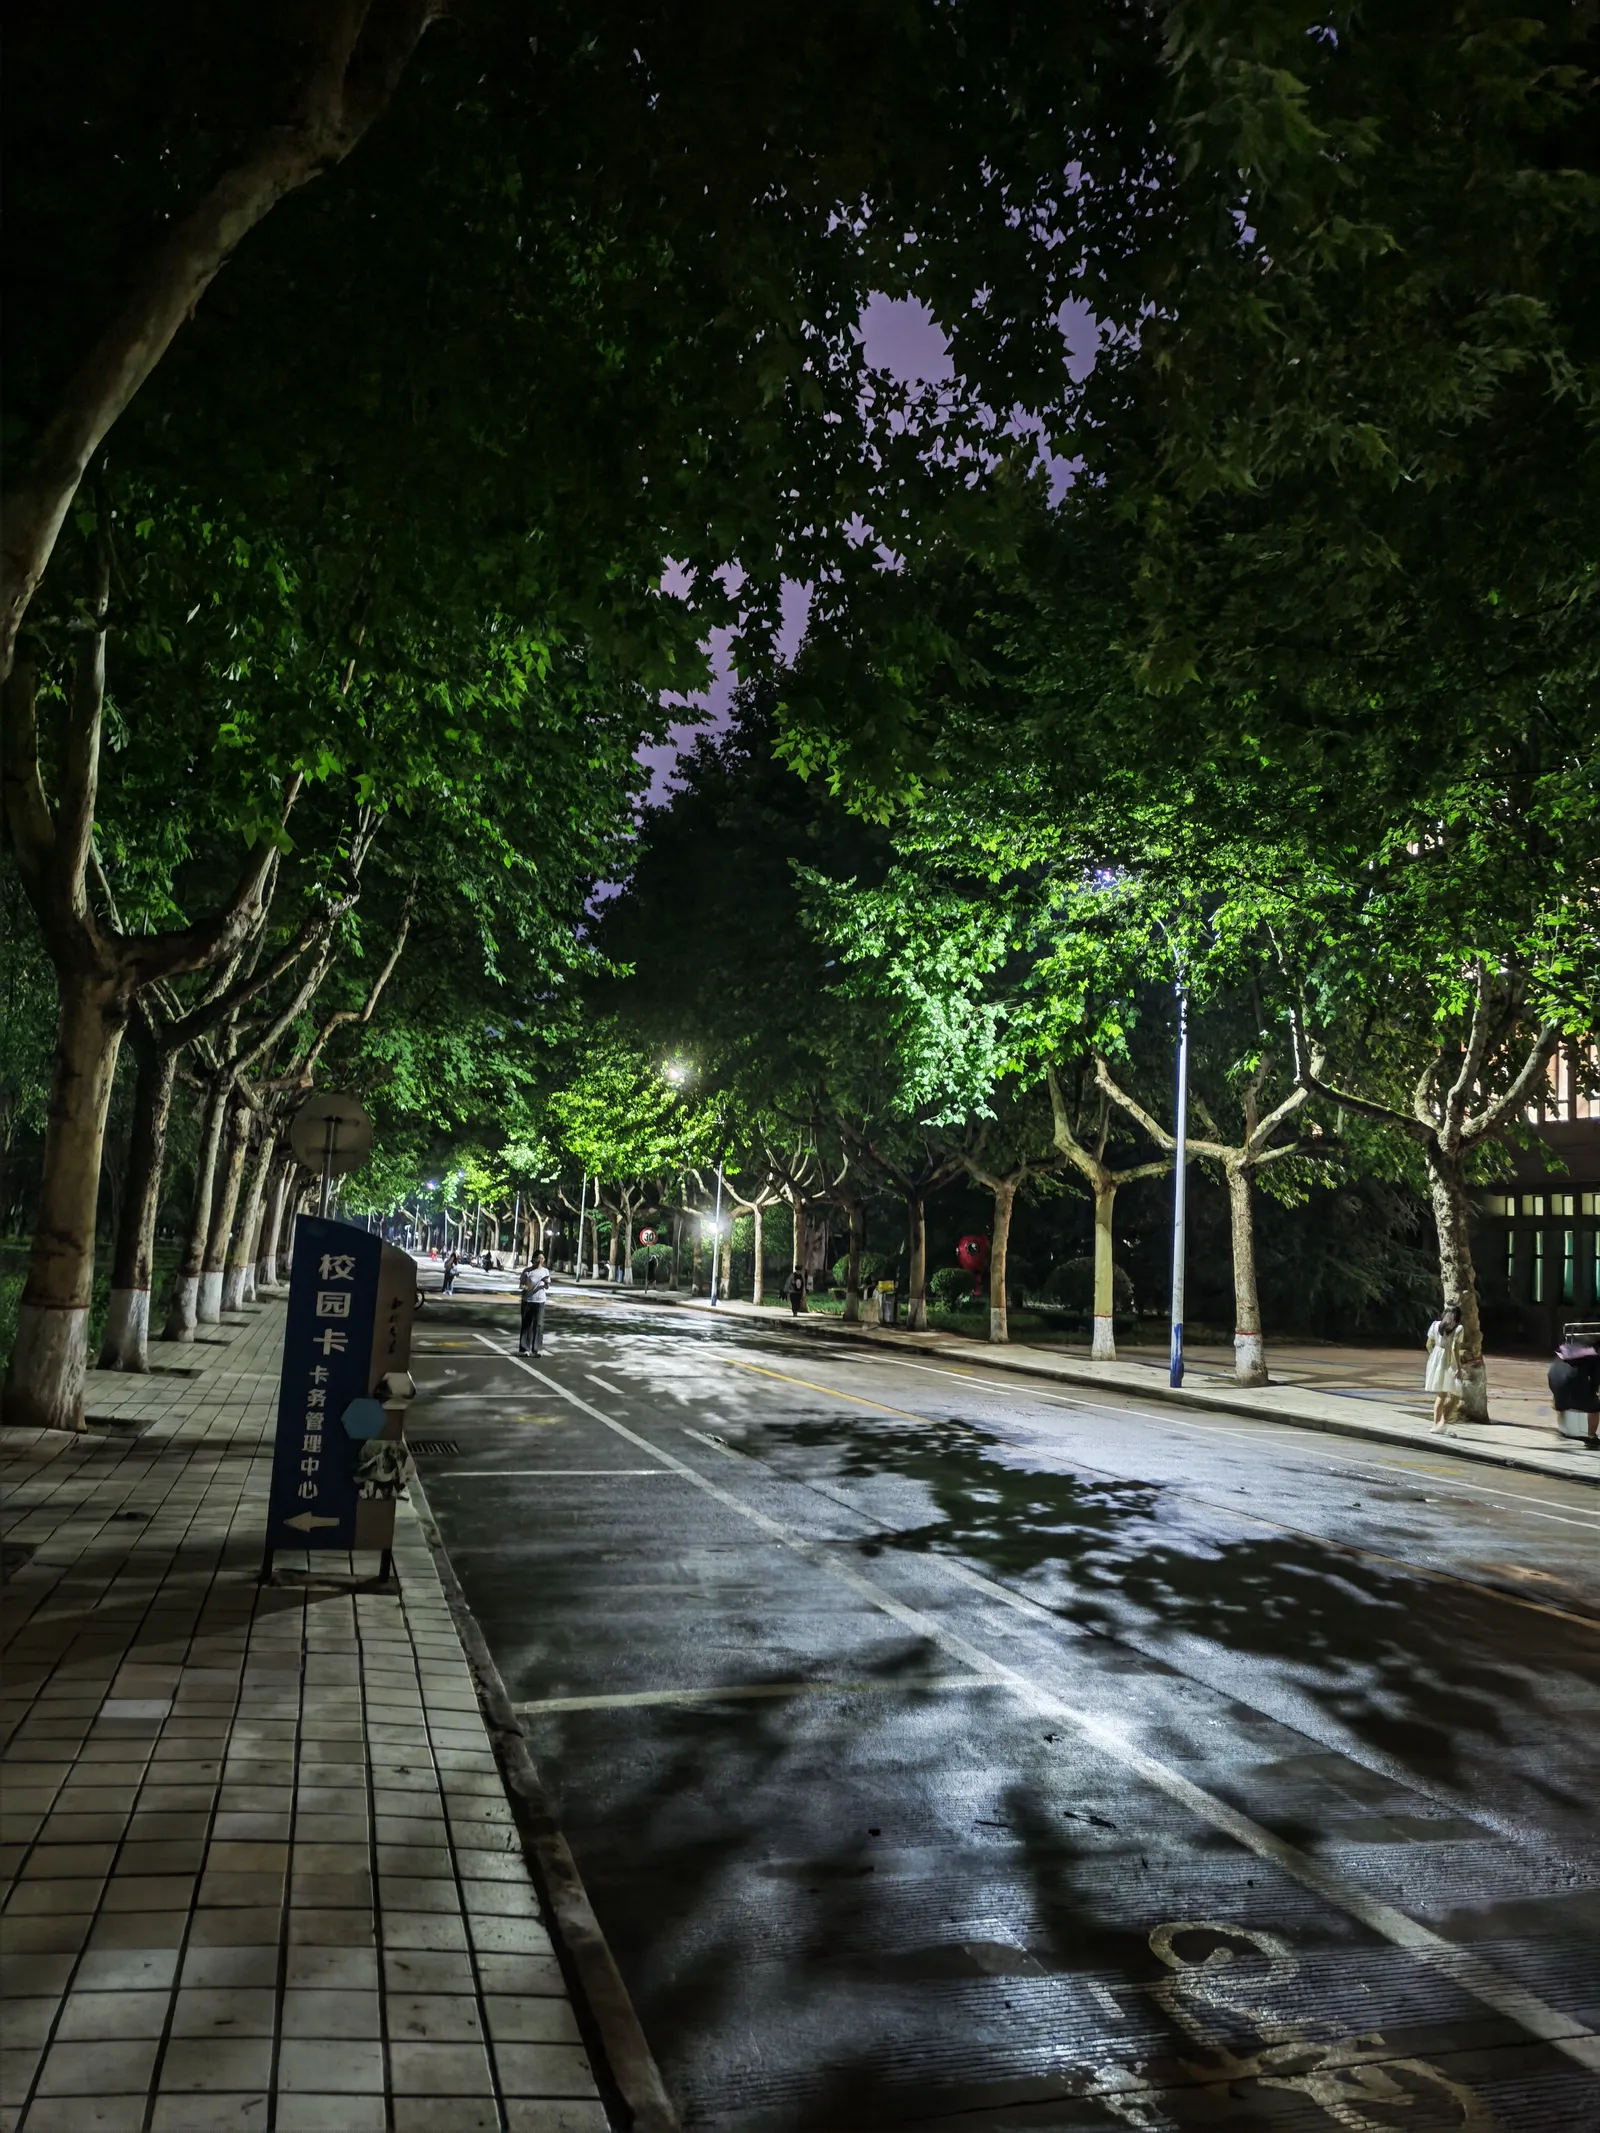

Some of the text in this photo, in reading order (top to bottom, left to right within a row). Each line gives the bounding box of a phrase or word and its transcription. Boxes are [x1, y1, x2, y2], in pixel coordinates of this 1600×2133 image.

[643, 1232, 654, 1242] 30
[312, 1253, 356, 1355] 校园卡
[297, 1364, 330, 1500] 卡务管理中心
